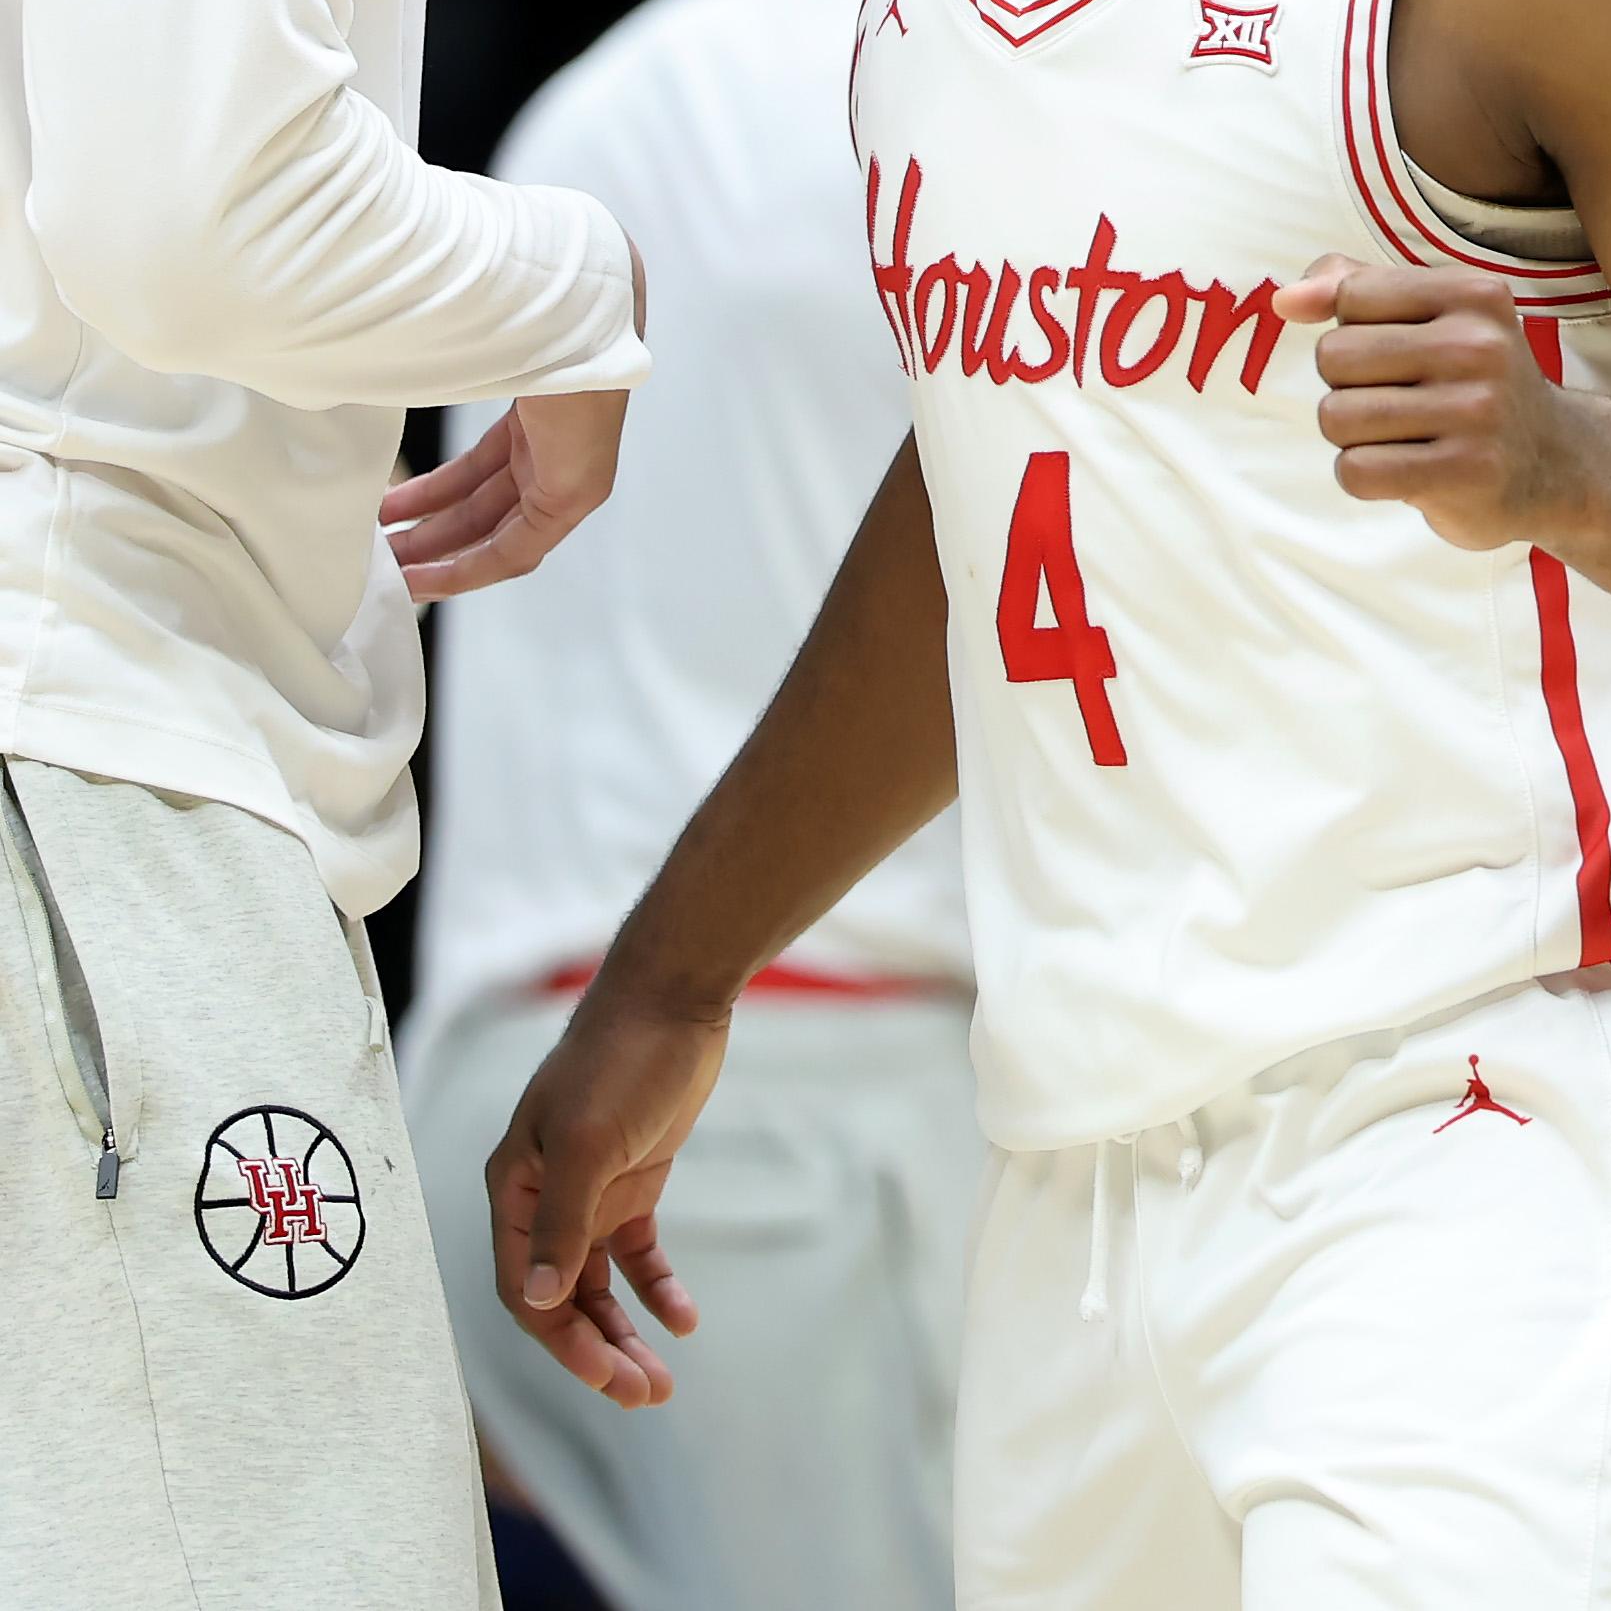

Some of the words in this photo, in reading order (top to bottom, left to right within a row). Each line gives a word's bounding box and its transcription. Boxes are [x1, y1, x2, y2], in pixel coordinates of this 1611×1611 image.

[1194, 0, 1277, 61] XII
[866, 151, 1287, 393] Houston
[997, 450, 1128, 768] 4
